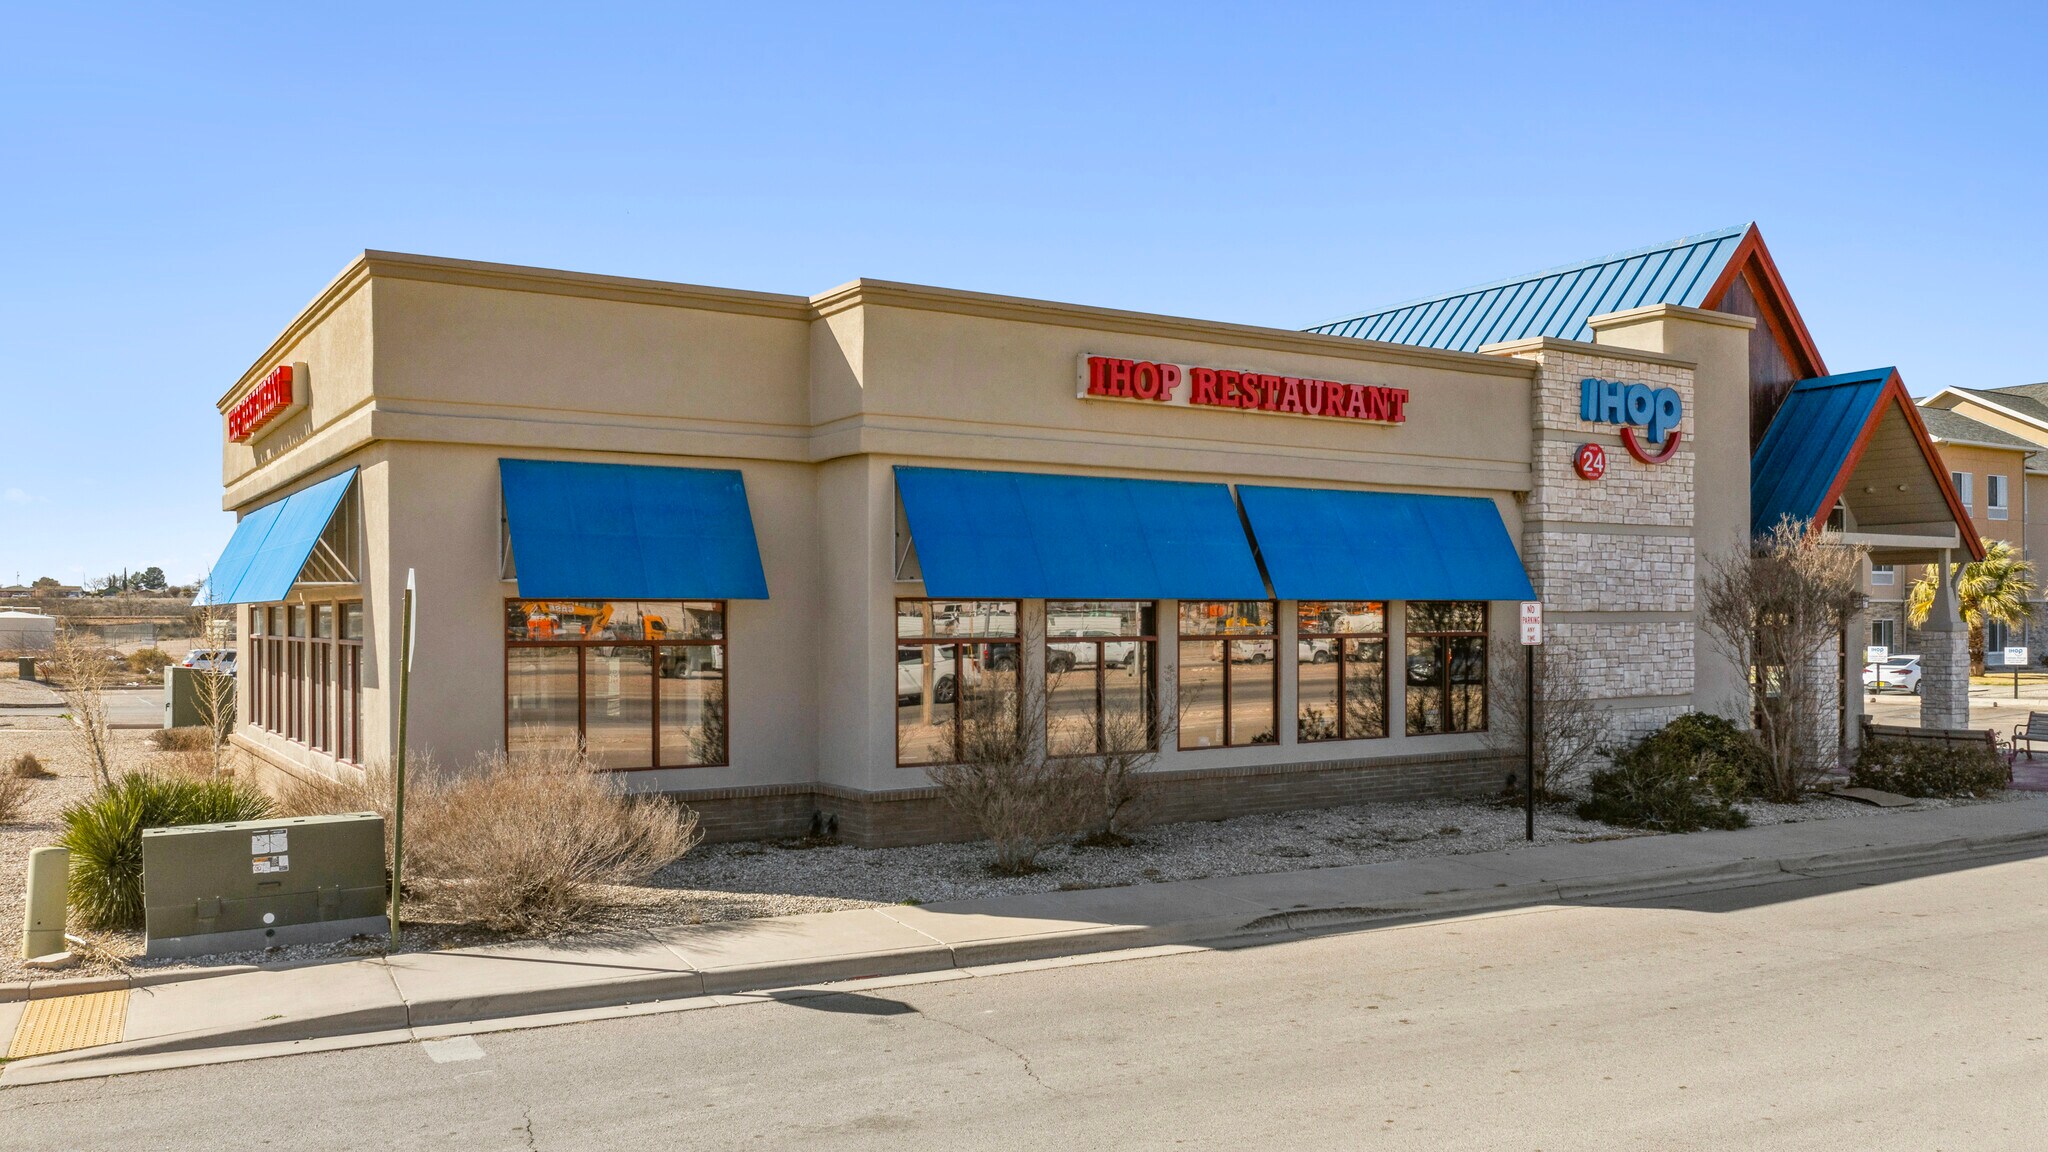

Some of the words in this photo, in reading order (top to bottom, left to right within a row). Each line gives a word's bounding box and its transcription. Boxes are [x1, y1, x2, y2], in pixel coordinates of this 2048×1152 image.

[1088, 356, 1182, 401] IHOP
[1189, 367, 1409, 423] RESTAURANT
[1580, 378, 1682, 444] IHOP
[1583, 451, 1604, 473] 24
[1522, 616, 1540, 624] PARKING
[1527, 605, 1535, 613] NO
